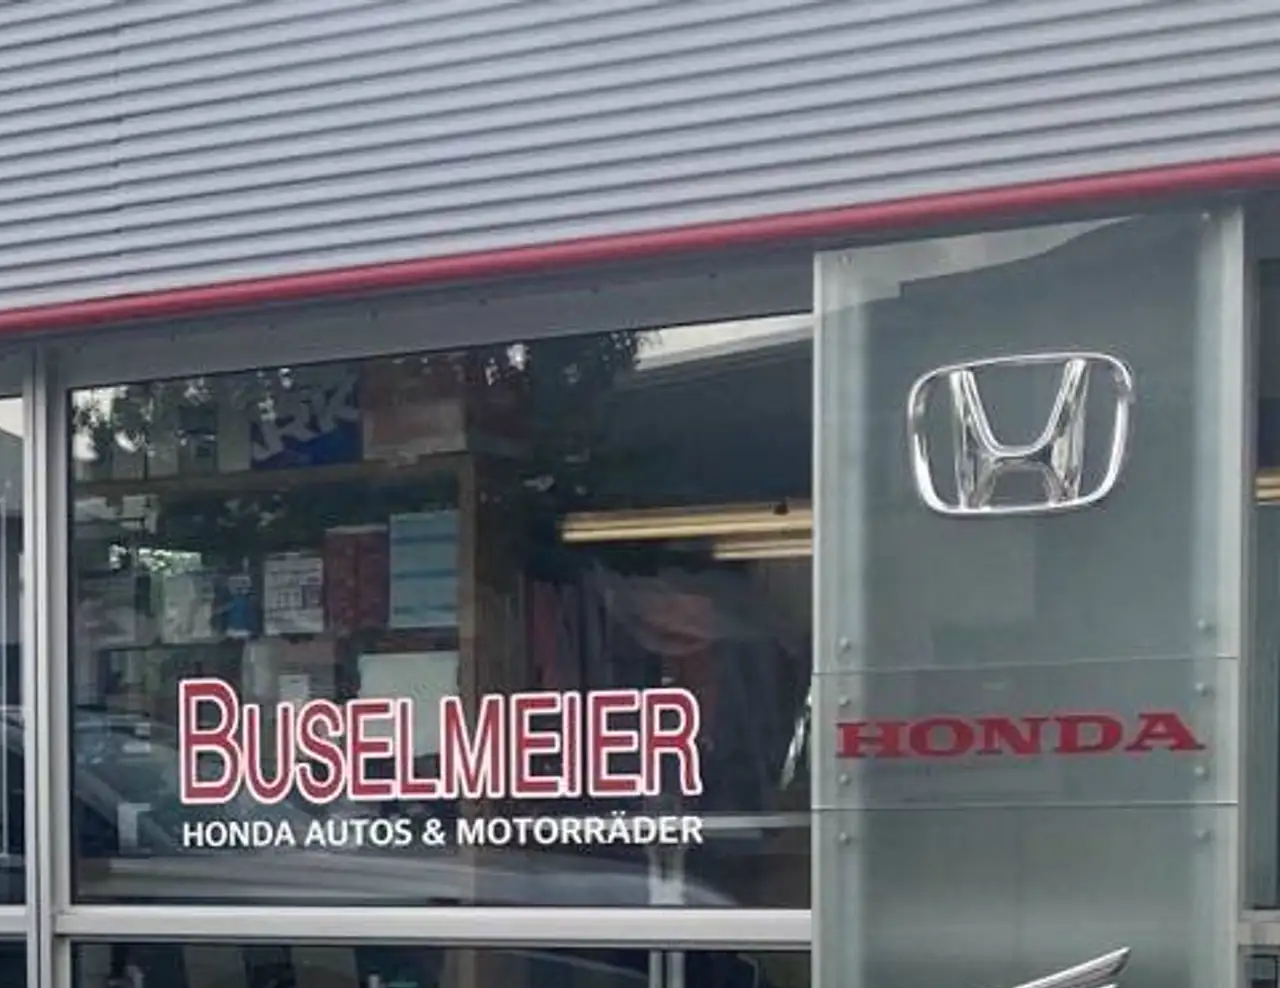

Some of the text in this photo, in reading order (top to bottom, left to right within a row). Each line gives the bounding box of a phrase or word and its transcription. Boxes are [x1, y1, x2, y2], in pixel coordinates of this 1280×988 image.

[178, 678, 704, 804] BUSELMEIER
[834, 712, 1207, 760] HONDA
[182, 810, 705, 849] HONDA AUTOS & MOTORRÄDER
